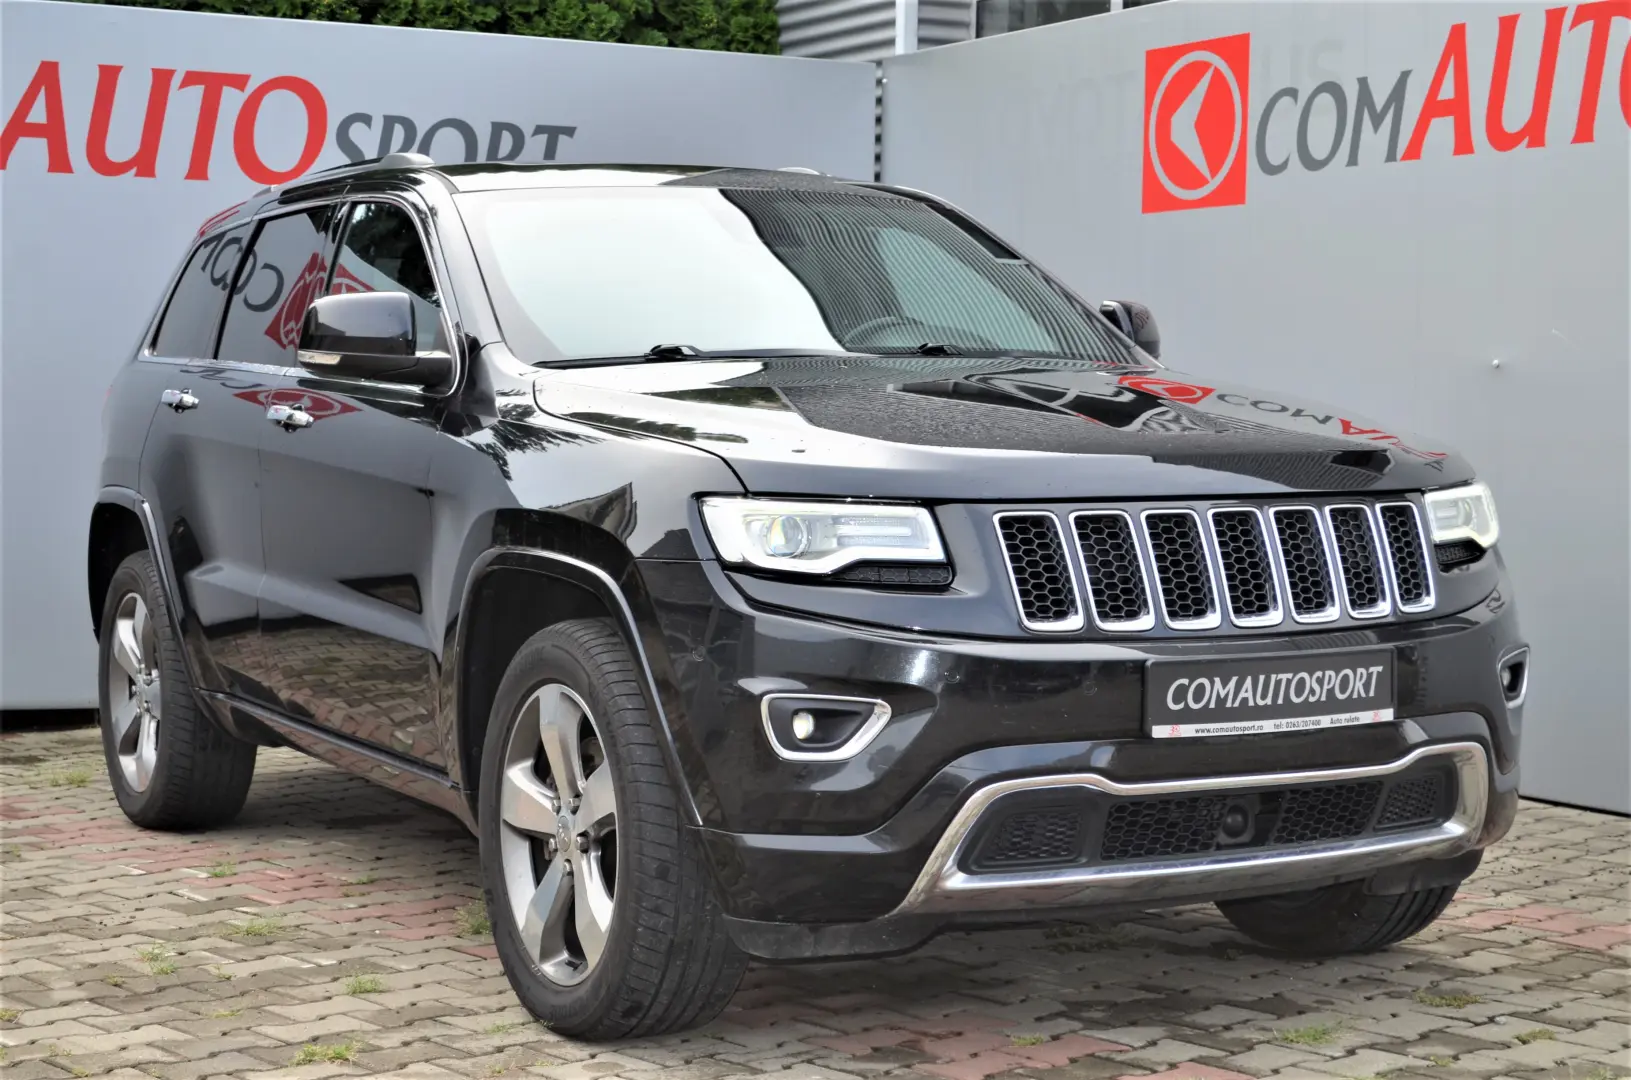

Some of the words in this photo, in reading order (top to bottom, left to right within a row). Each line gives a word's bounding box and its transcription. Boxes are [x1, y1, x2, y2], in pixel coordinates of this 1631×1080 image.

[1166, 666, 1384, 710] COMAUTOSPORT
[1194, 724, 1264, 734] www.comautosport.ro
[1329, 717, 1343, 725] Auto
